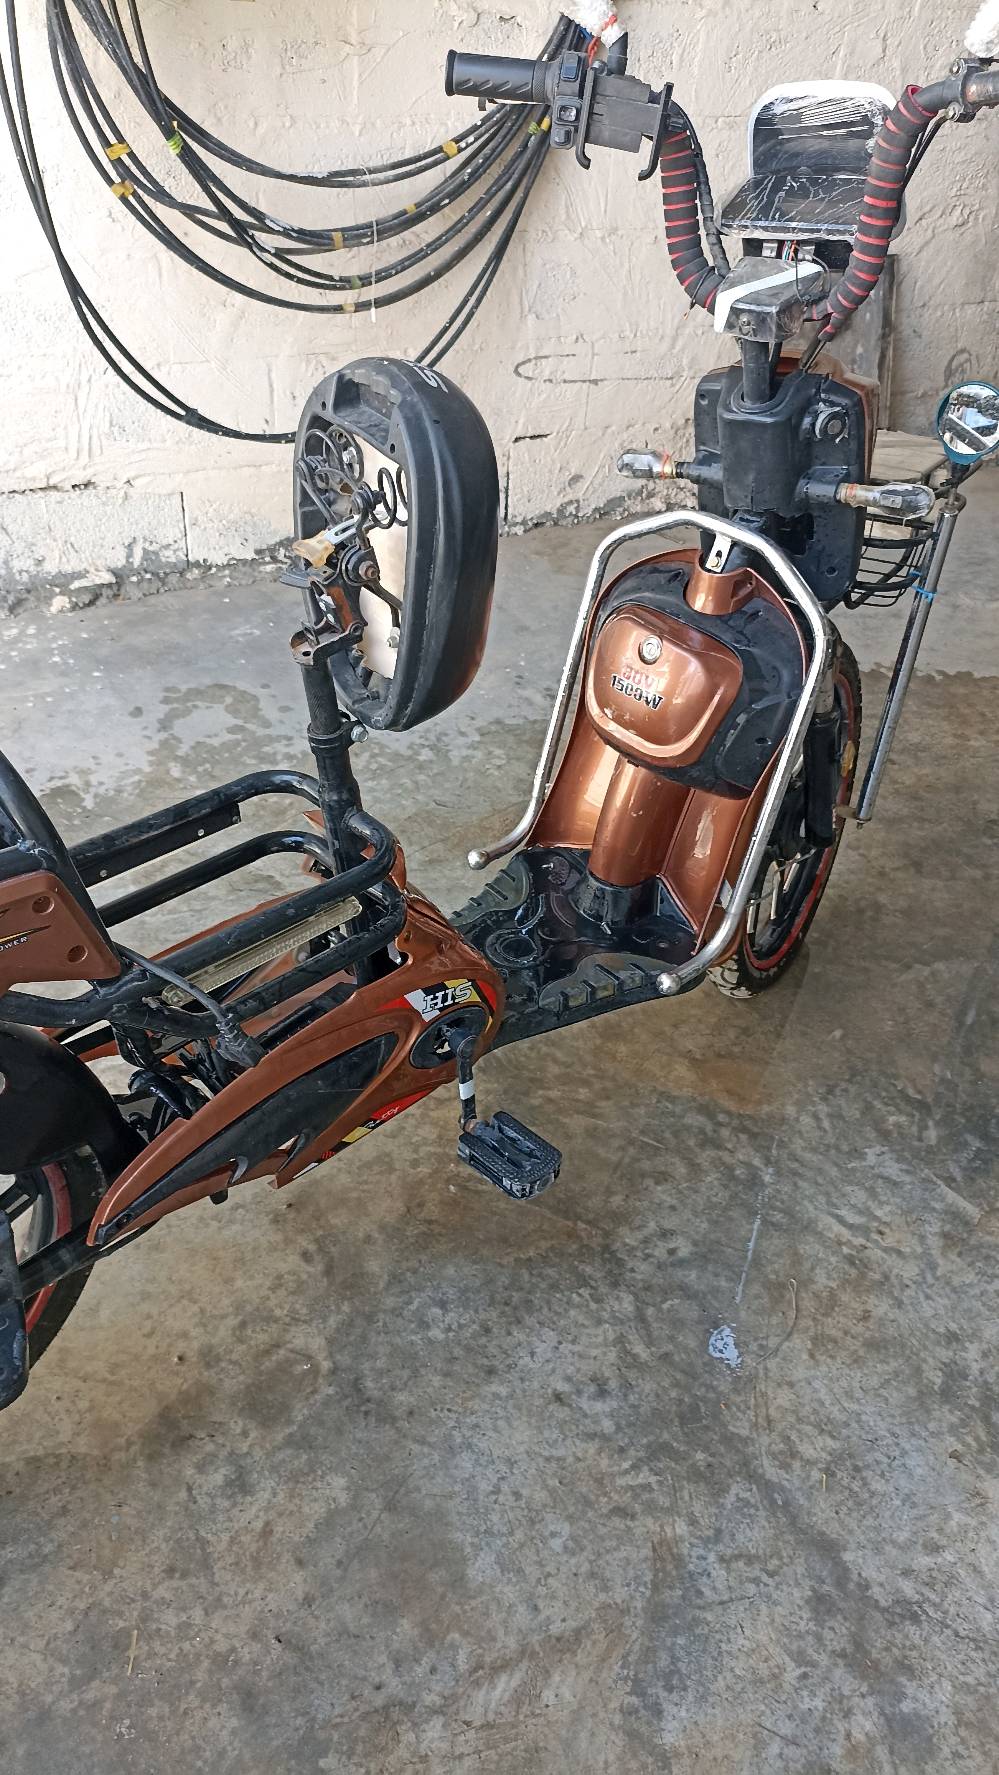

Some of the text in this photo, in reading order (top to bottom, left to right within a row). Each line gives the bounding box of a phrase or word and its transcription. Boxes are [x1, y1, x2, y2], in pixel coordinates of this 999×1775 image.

[611, 675, 664, 710] 1500W
[0, 936, 28, 952] OWER
[422, 981, 472, 1014] HIS
